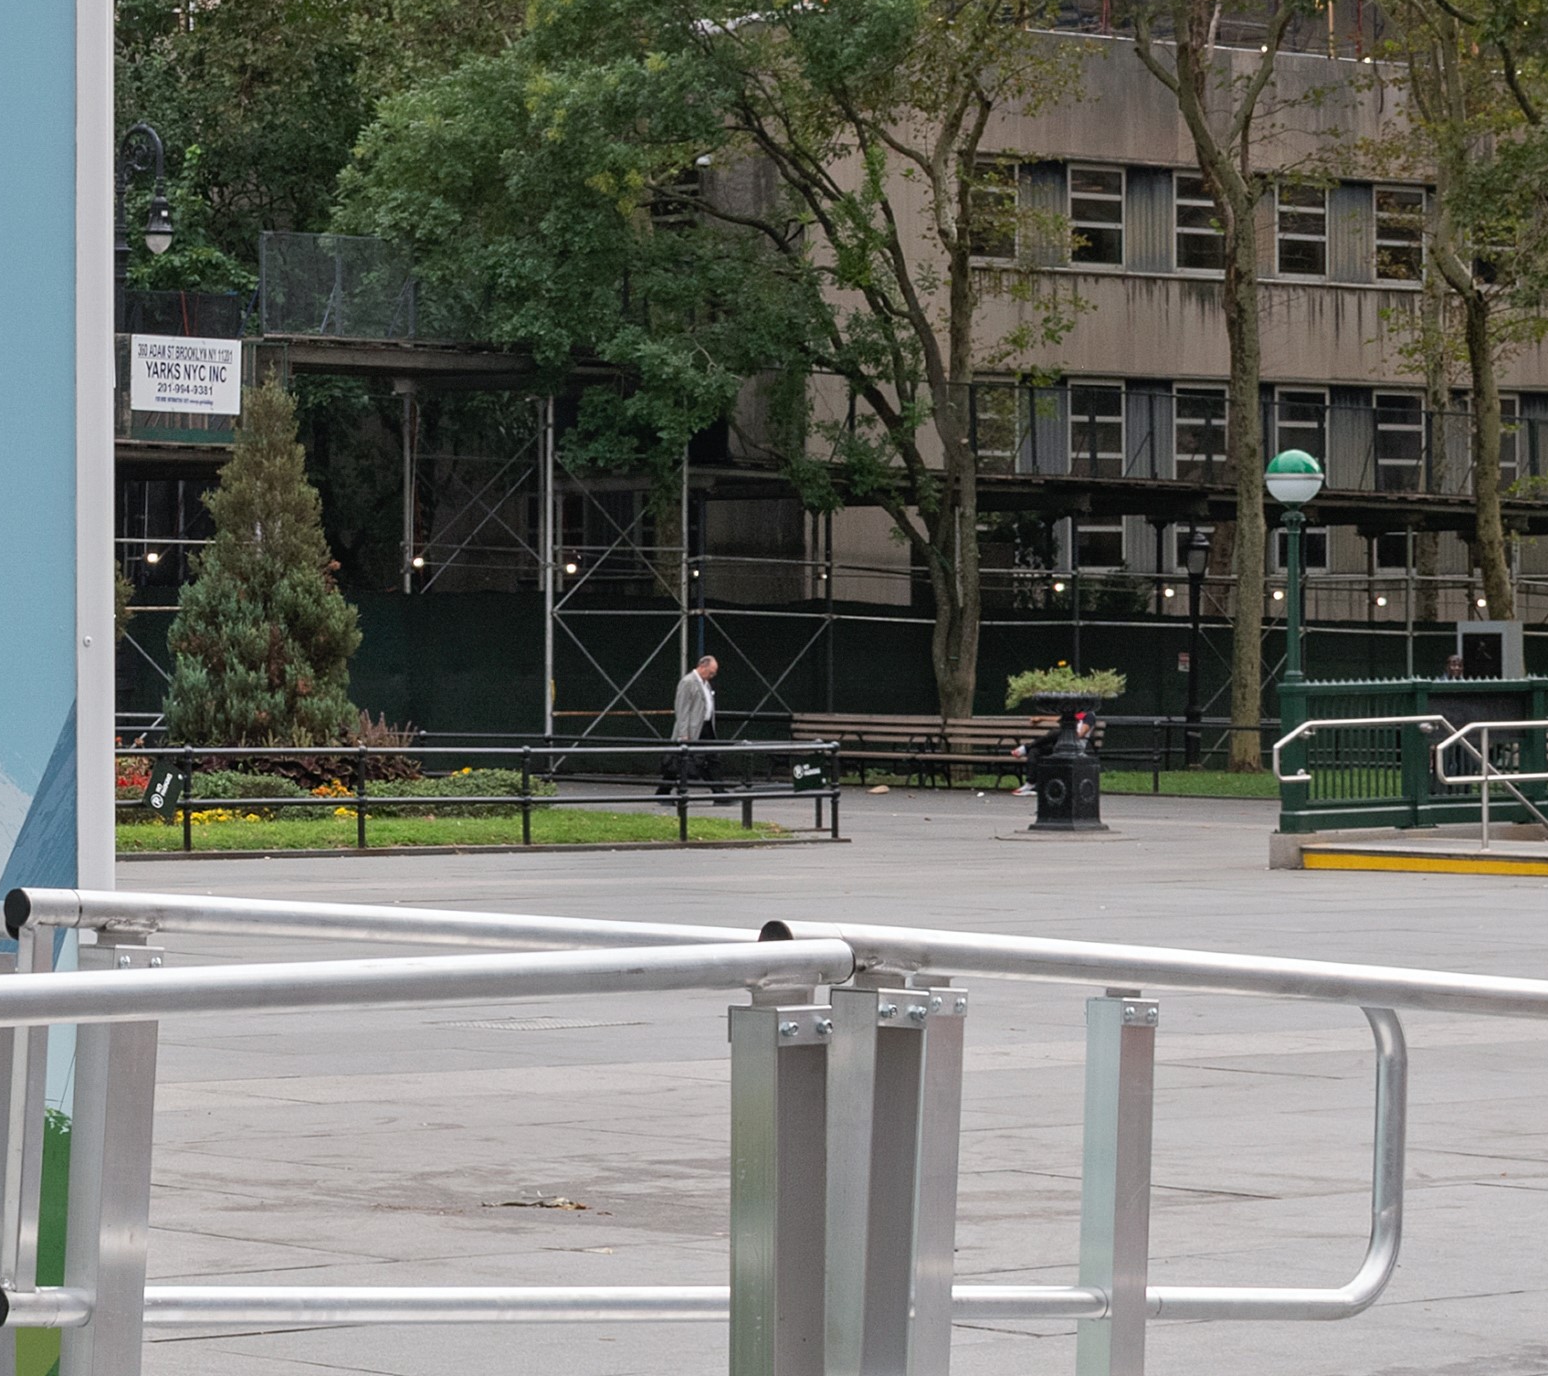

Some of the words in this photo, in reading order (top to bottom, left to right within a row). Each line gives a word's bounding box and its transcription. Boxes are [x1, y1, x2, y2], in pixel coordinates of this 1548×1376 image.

[146, 361, 181, 380] YARKS
[183, 363, 206, 381] NYC
[209, 365, 227, 383] INC
